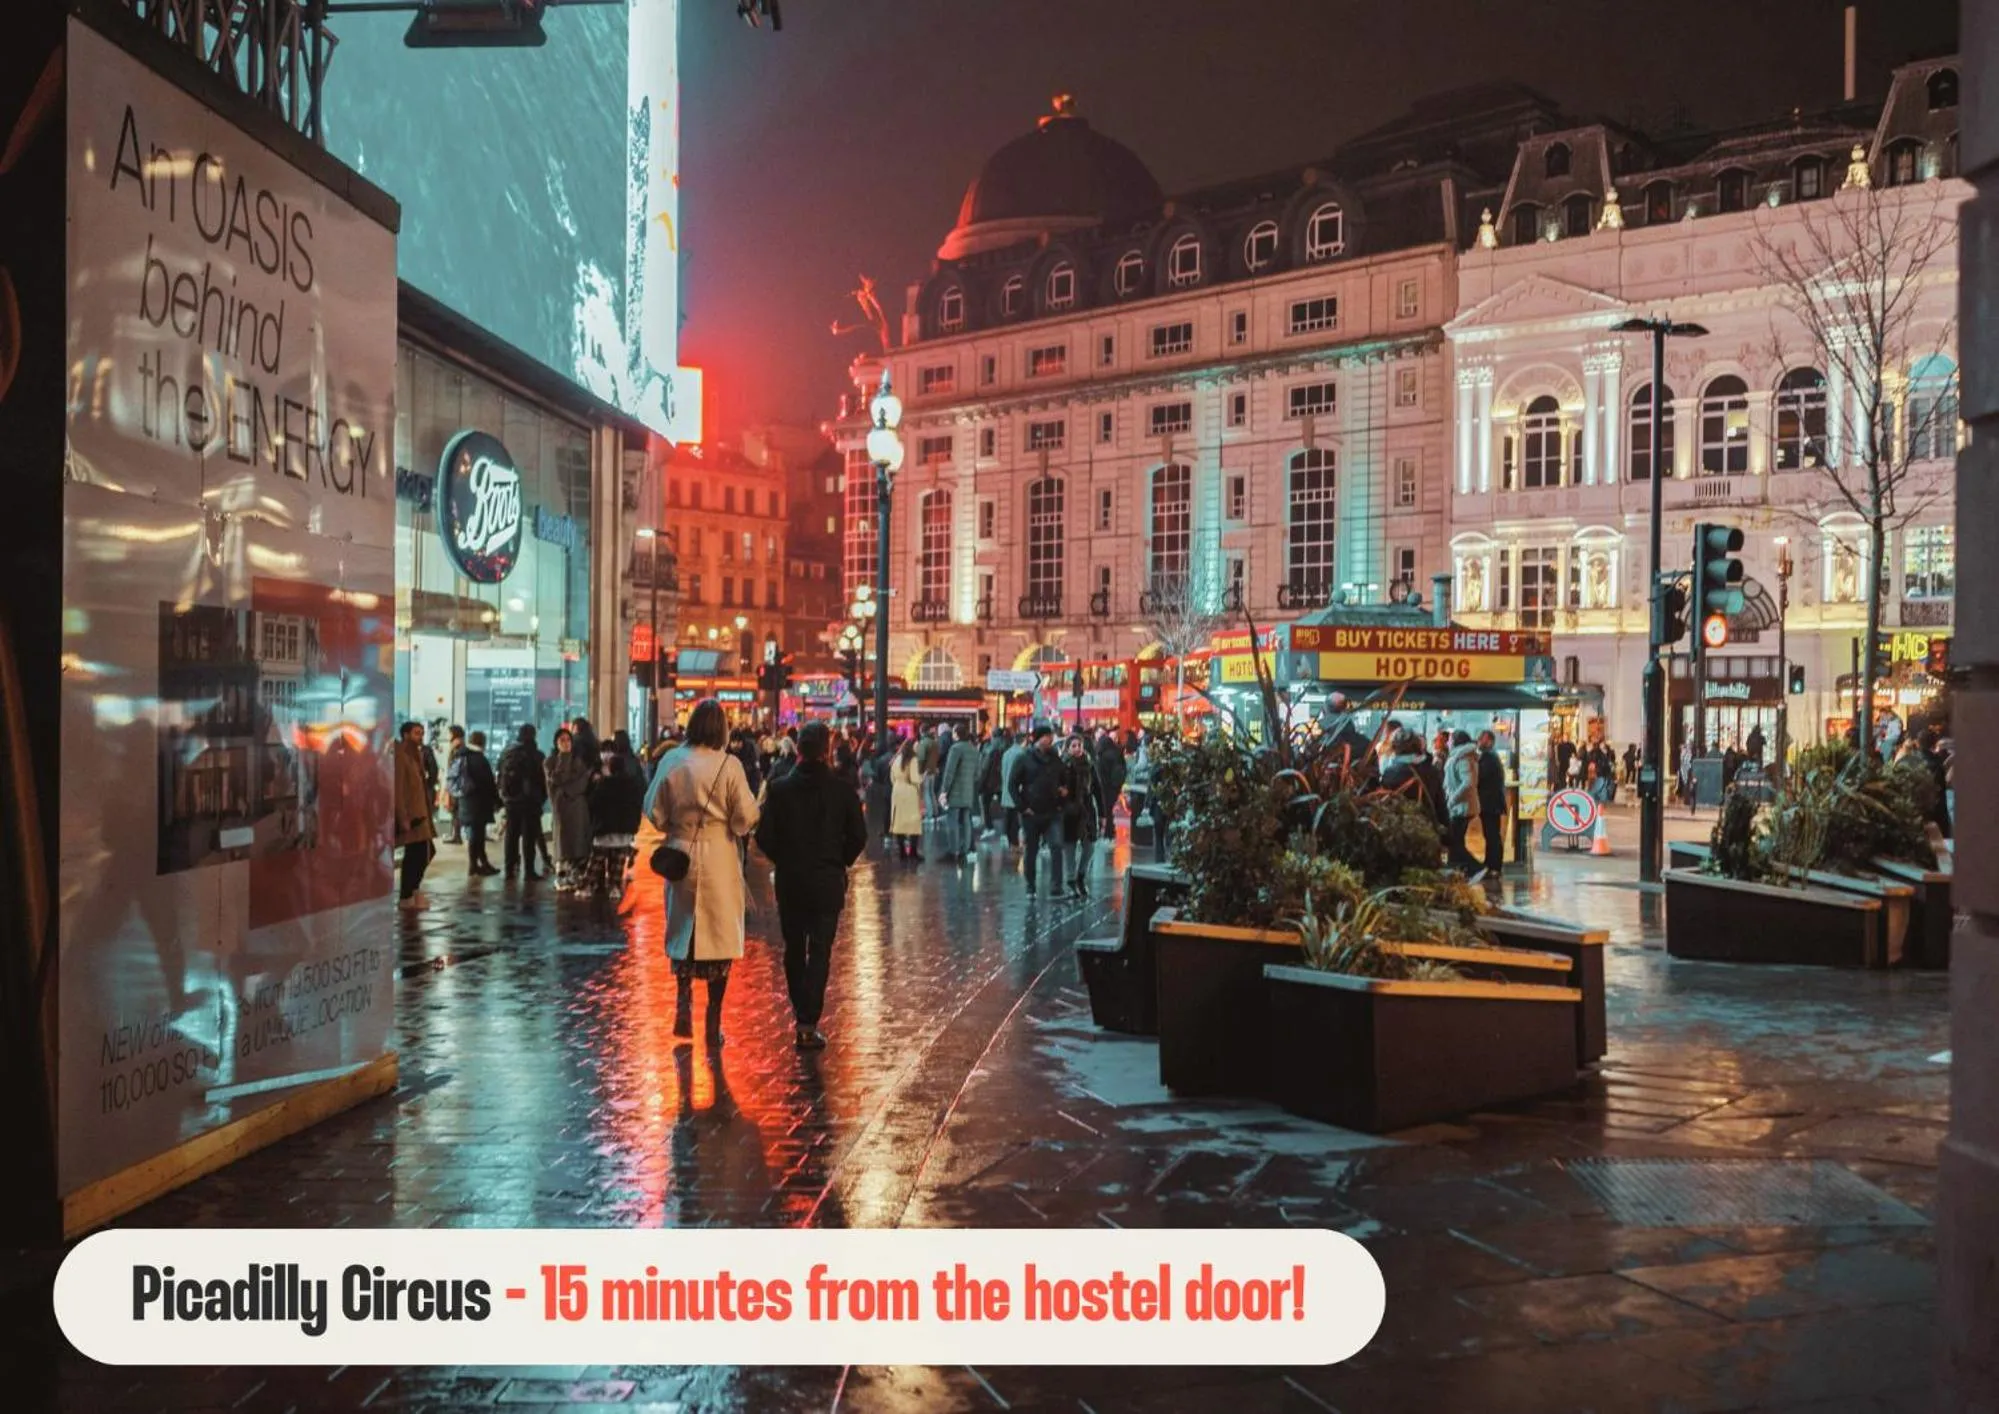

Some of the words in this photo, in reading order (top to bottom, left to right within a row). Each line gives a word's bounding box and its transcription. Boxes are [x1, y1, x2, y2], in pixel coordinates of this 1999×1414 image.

[111, 104, 175, 223] An
[192, 152, 314, 293] OASIS
[139, 233, 285, 375] behind
[138, 348, 209, 453] the
[226, 377, 375, 498] ENERGY
[456, 456, 521, 557] Boots
[1335, 629, 1374, 649] BUY
[1376, 630, 1450, 650] TICKETS
[1453, 632, 1501, 651] HERE
[1375, 656, 1471, 679] HOTDOG
[99, 1056, 169, 1115] 110,000
[172, 1047, 199, 1087] SQ
[101, 1019, 147, 1066] NEW
